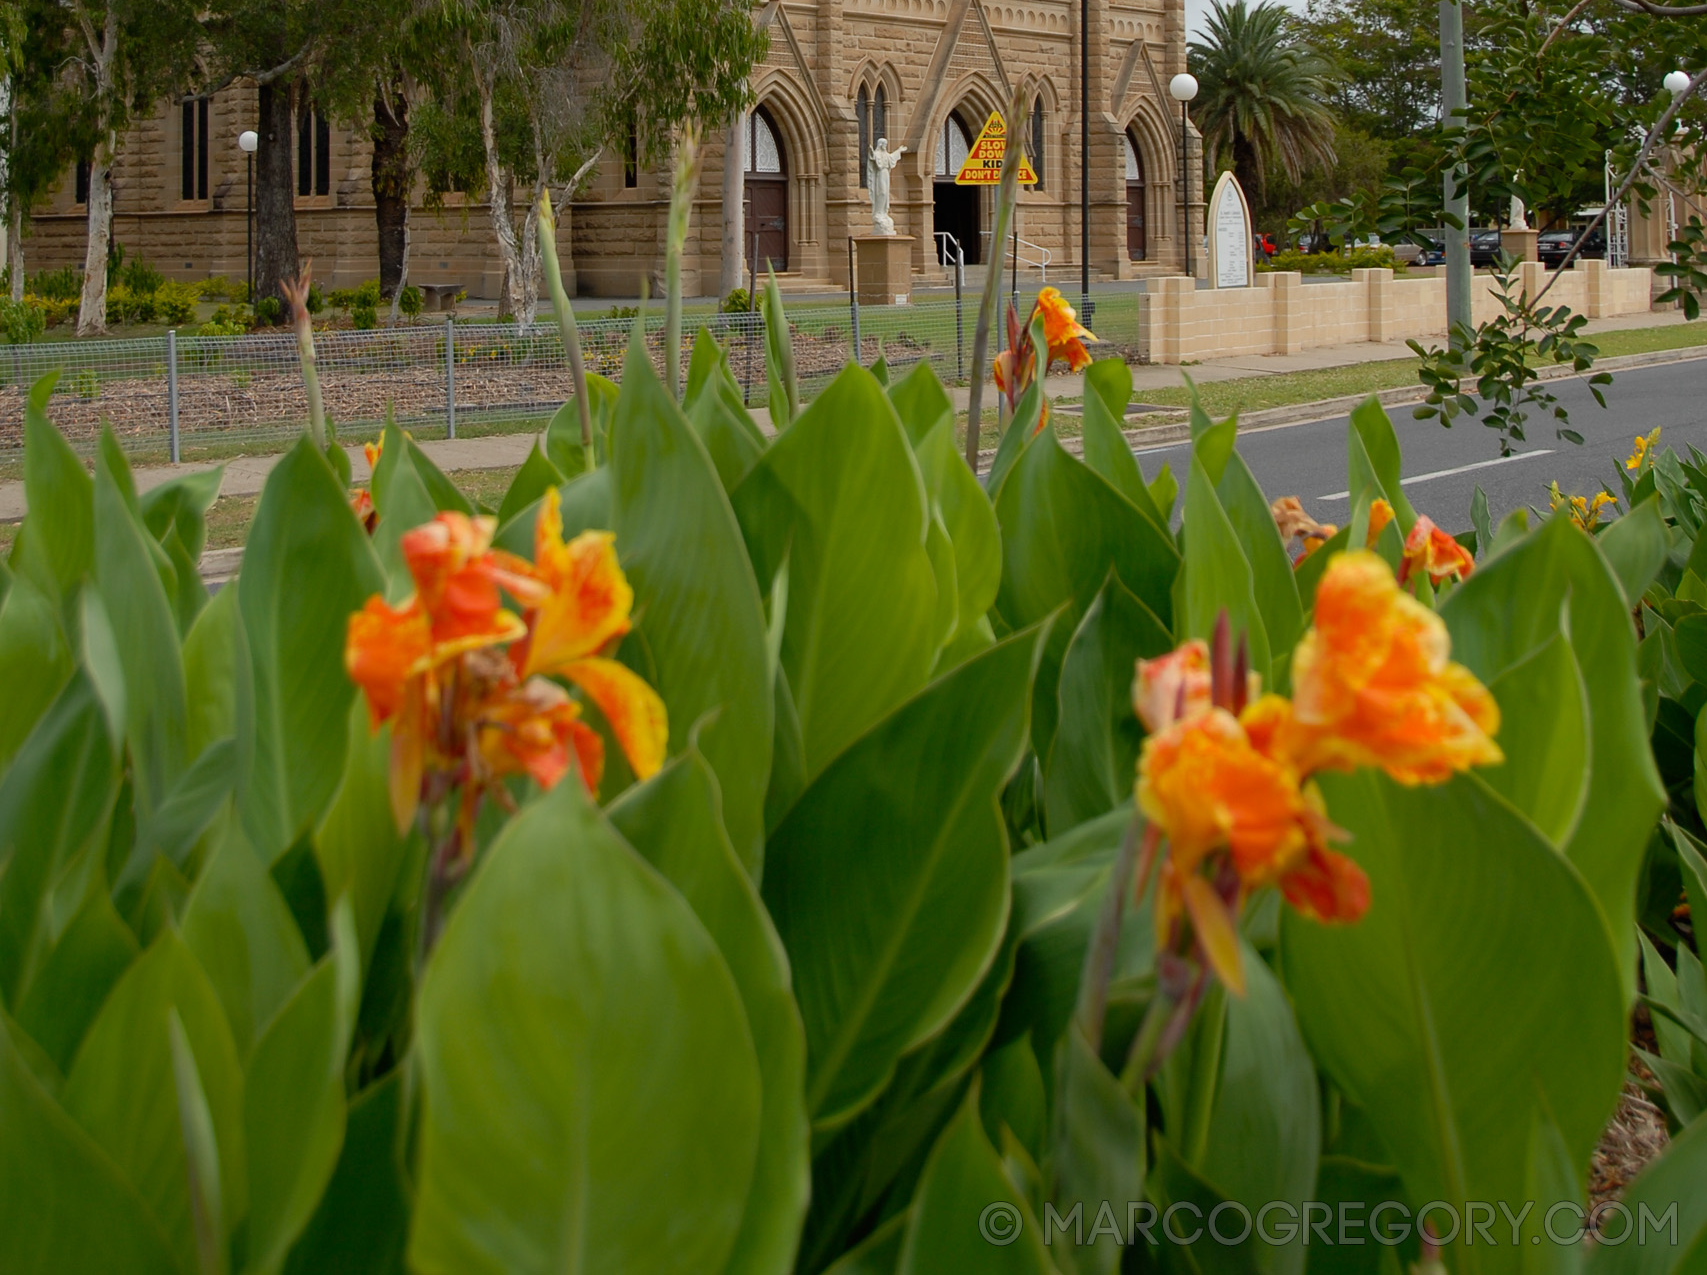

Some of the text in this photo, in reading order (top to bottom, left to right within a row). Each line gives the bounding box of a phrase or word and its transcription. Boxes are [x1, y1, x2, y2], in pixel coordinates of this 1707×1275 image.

[978, 150, 1004, 158] DOW
[982, 160, 1003, 168] KID
[965, 170, 1027, 179] DON'T BCE
